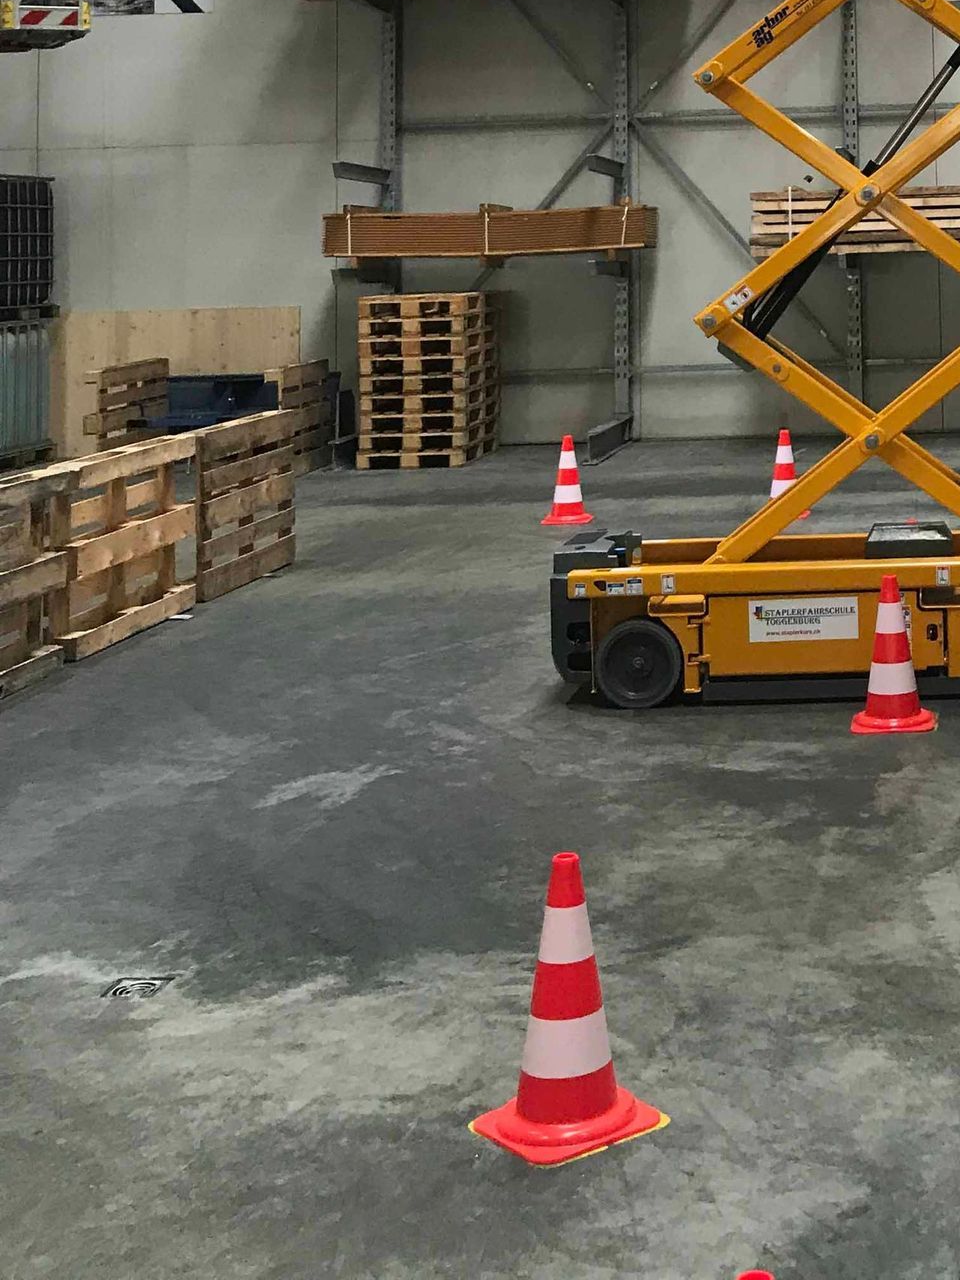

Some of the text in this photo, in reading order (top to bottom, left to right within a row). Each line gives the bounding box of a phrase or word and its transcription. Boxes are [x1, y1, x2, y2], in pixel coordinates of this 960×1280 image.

[752, 6, 790, 40] arbor
[754, 29, 774, 48] ag
[764, 606, 856, 617] STAPLERFAHRSCHULE
[765, 617, 821, 626] TOGGENBURG
